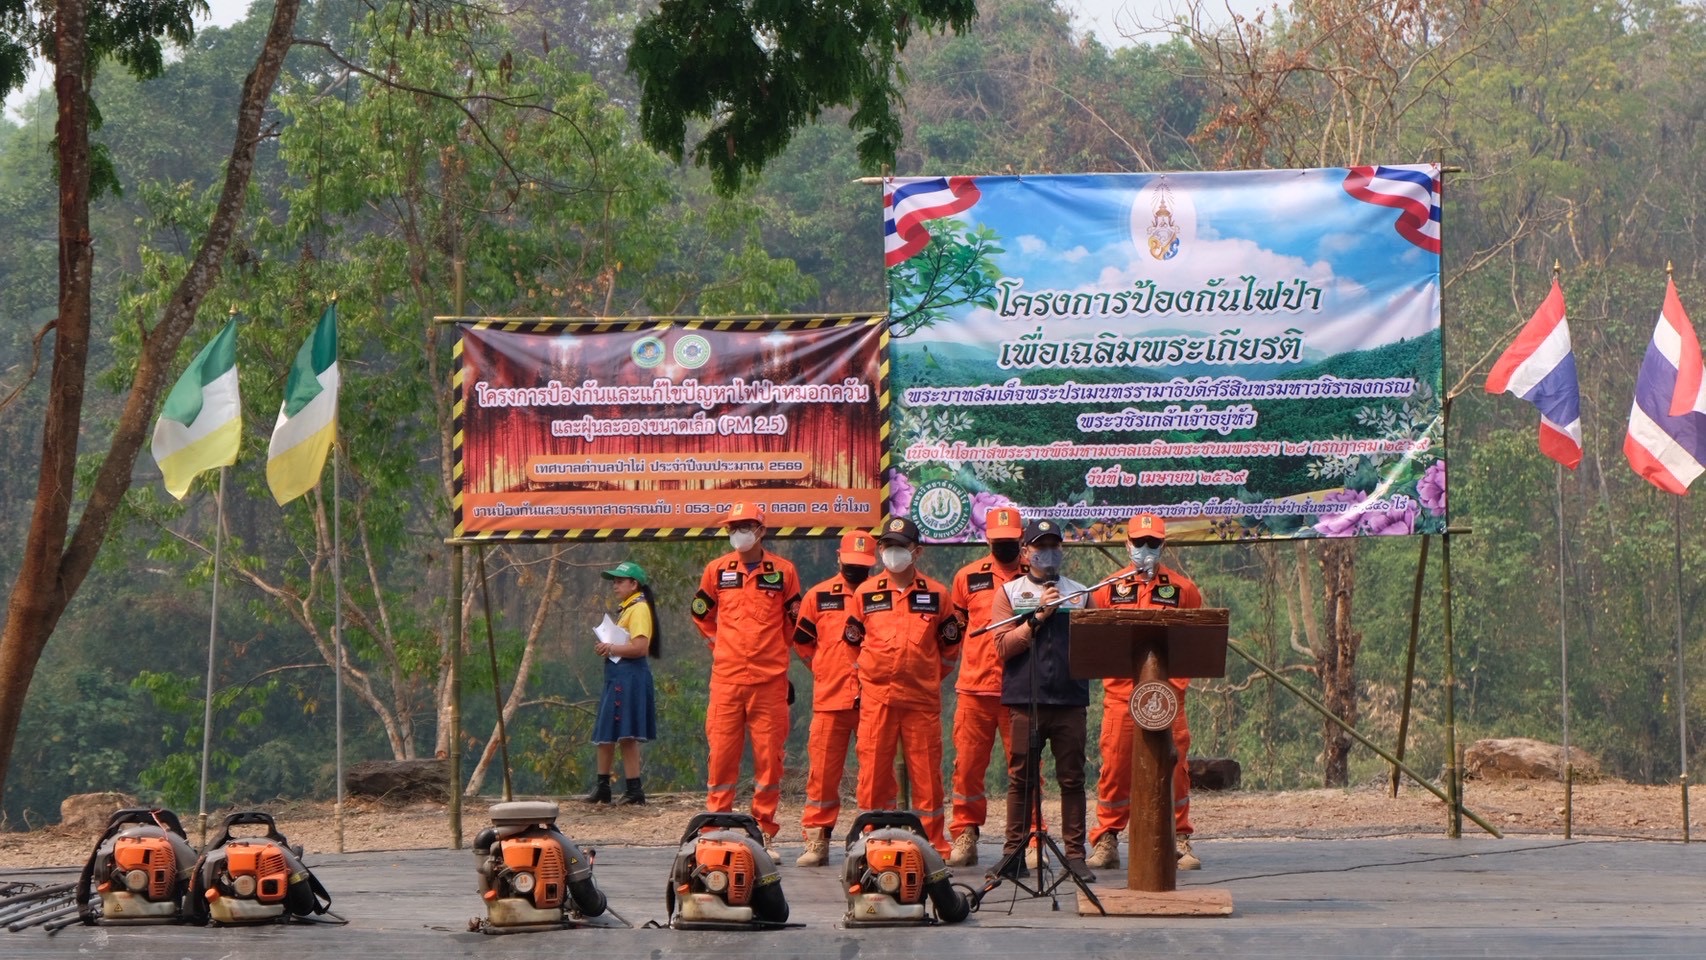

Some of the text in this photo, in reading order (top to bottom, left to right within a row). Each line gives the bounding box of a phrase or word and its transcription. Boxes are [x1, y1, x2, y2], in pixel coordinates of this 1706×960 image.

[999, 275, 1323, 317] โครงการป้องกันไฟป่า
[1000, 326, 1304, 367] เพื่อเฉลิมพระเกียรติ
[477, 379, 868, 408] โครงการป้องกันและแก้ไขปัญหาไฟป่าหมอกควัน
[907, 378, 1411, 403] พระบาทสมเด็จพระปรเมนทรรามาธิบดีศรีสินทรมหาวชิราลงกรณ
[553, 413, 787, 441] และฝุ่นละอองขนาดเล็ก (PM 2.5)
[1080, 405, 1255, 432] พระวชิรเกล้าเจ้าอยู่หัว
[906, 439, 1428, 460] เนื่องในโอกาสพระราชพิธีมหามงคลเฉลิมพระชนมพรรษา ๒๘ กรกฎาคม ๒๕๖๙
[535, 459, 803, 474] เทศบาลตำบลป่าไผ่ ประจำปีงบประมาณ 2569
[1087, 466, 1247, 485] วันที่ ๒ เมษายน ๒๕๖๙
[473, 501, 672, 518] งานป้องกันและบรรเทาสาธารณภัย
[771, 503, 806, 514] ตลอด
[811, 504, 829, 514] 24
[834, 497, 870, 514] ชั่วโมง
[1394, 495, 1408, 509] ไร่
[911, 513, 969, 538] MAEJO UNIVERSITY
